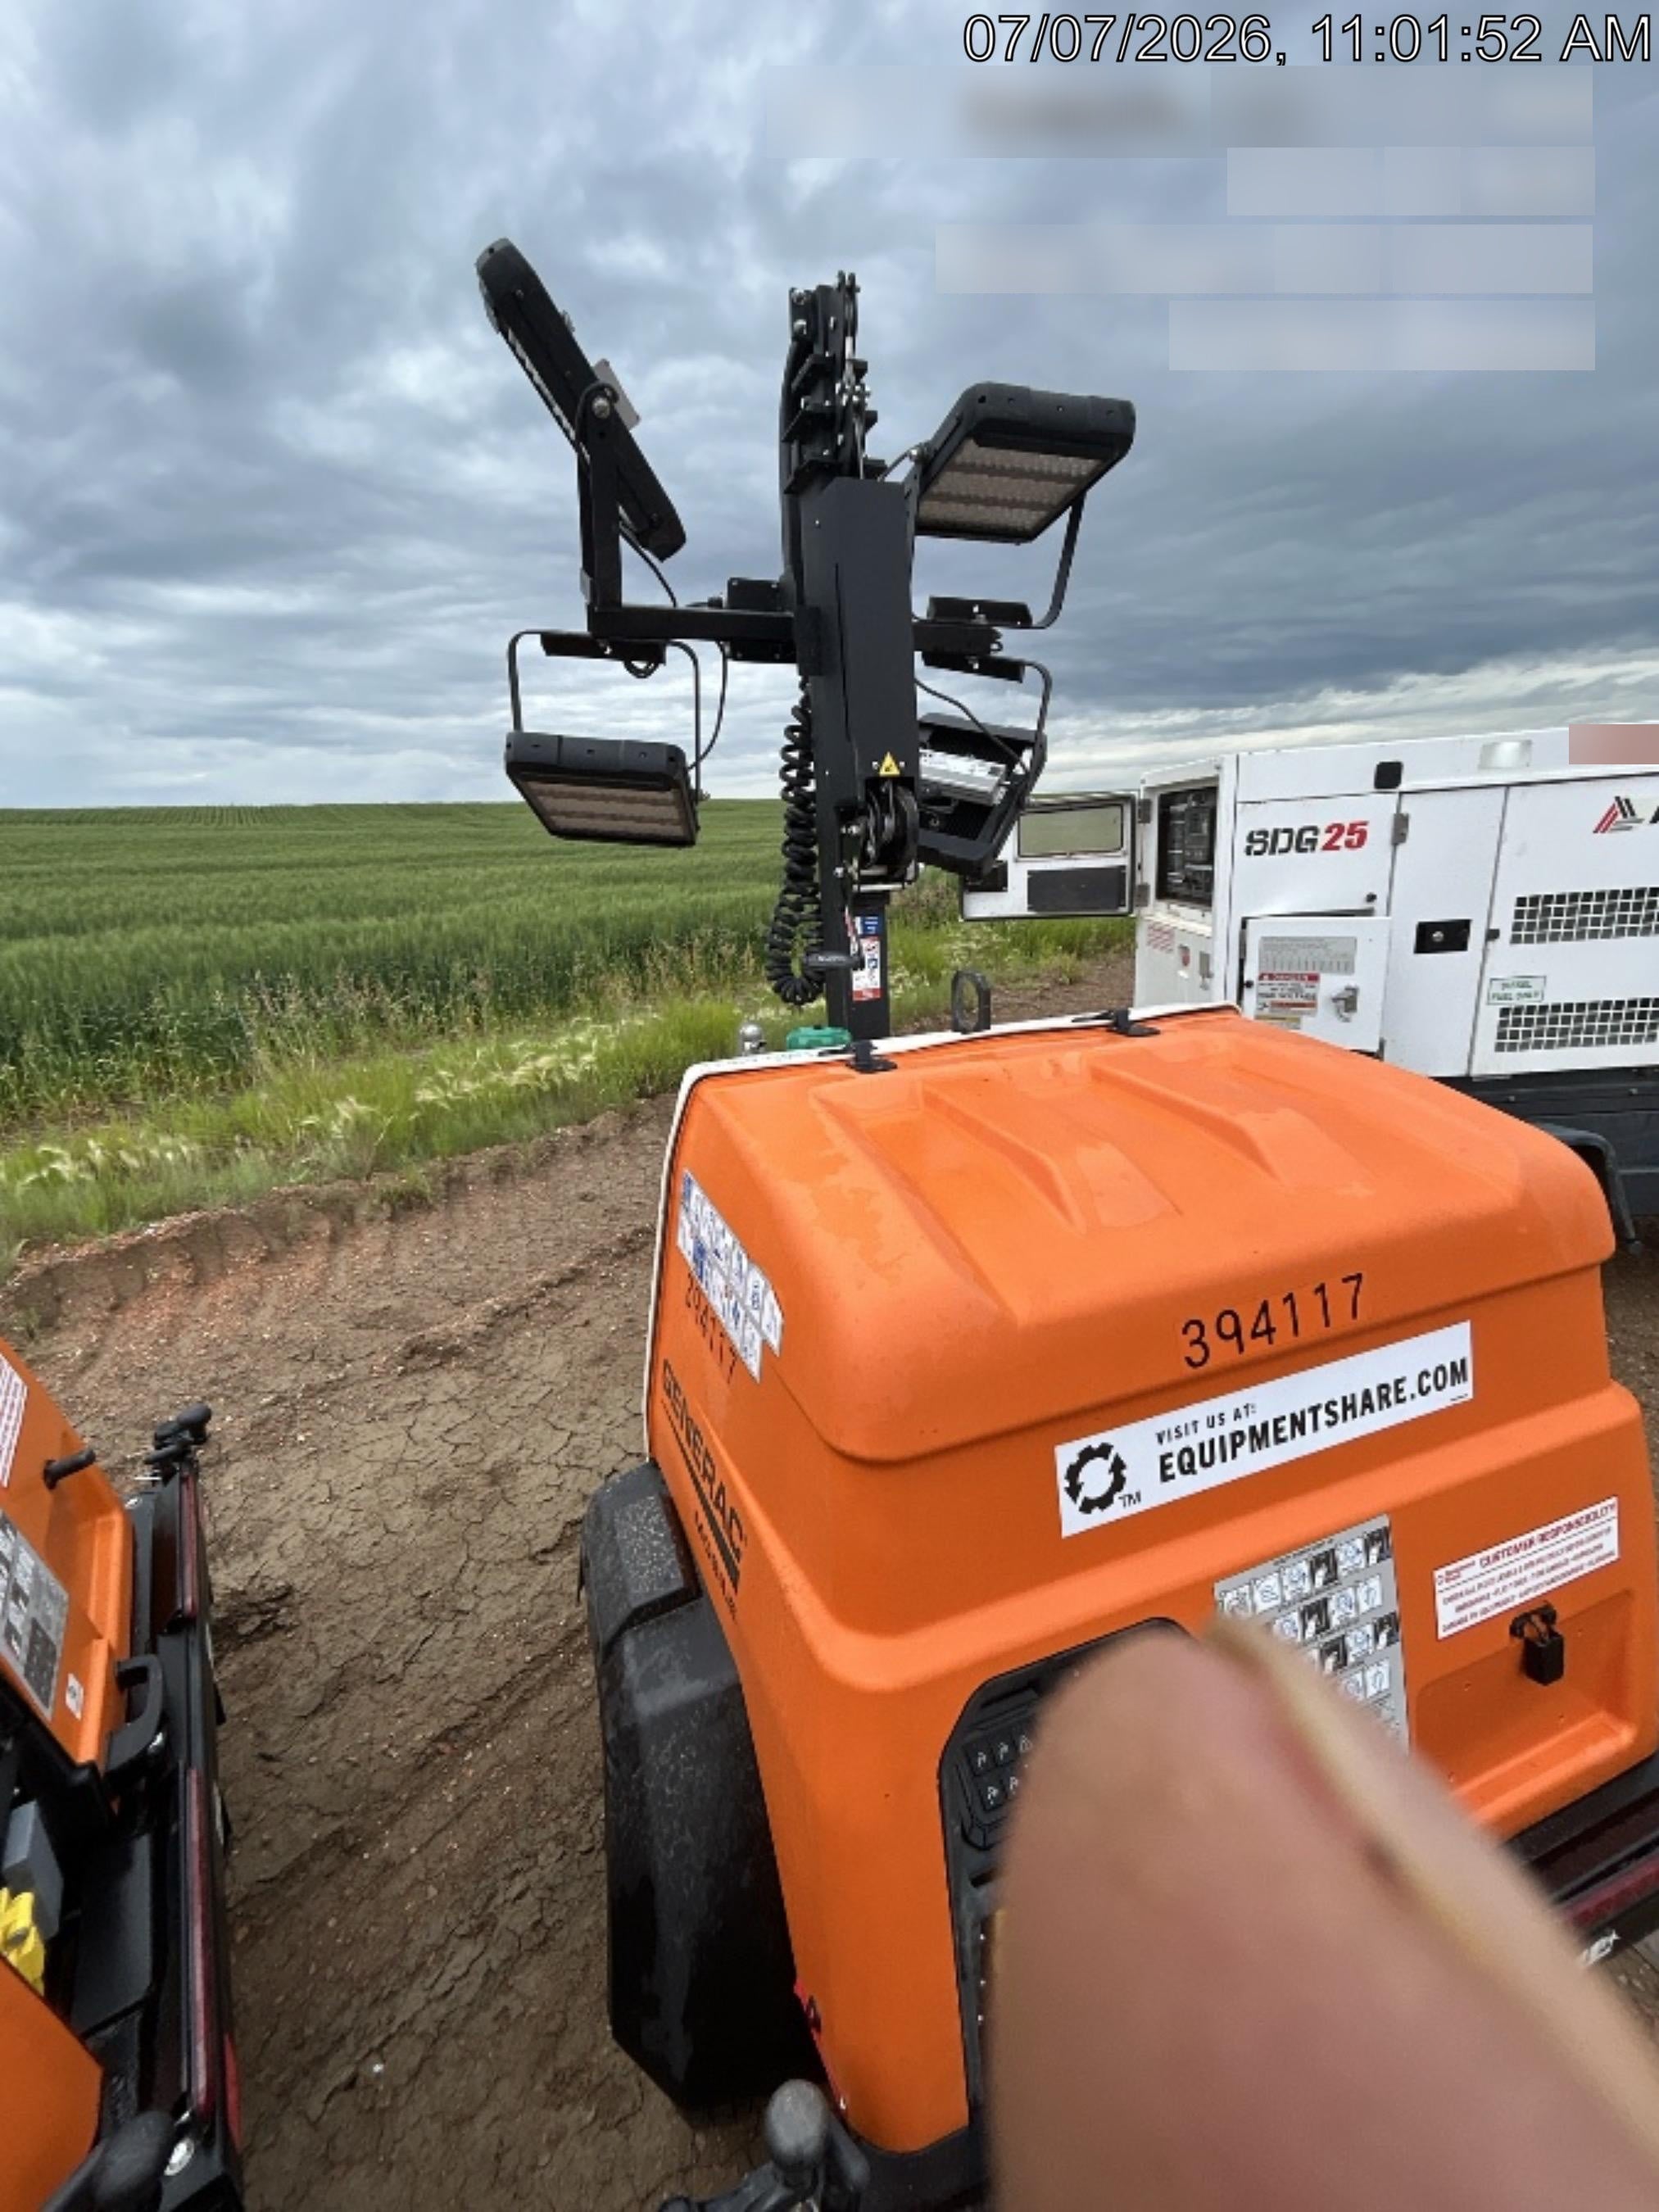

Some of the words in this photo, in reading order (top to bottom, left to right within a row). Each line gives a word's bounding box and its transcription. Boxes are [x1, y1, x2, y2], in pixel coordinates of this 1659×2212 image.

[1181, 1272, 1363, 1368] 394117
[663, 1358, 744, 1563] GENERAC
[1155, 1420, 1199, 1445] VISIT
[1206, 1412, 1226, 1429] US
[1233, 1403, 1257, 1422] AT:
[1158, 1358, 1469, 1483] EQUIPMENTSHARE.COM
[1118, 1489, 1142, 1507] TM
